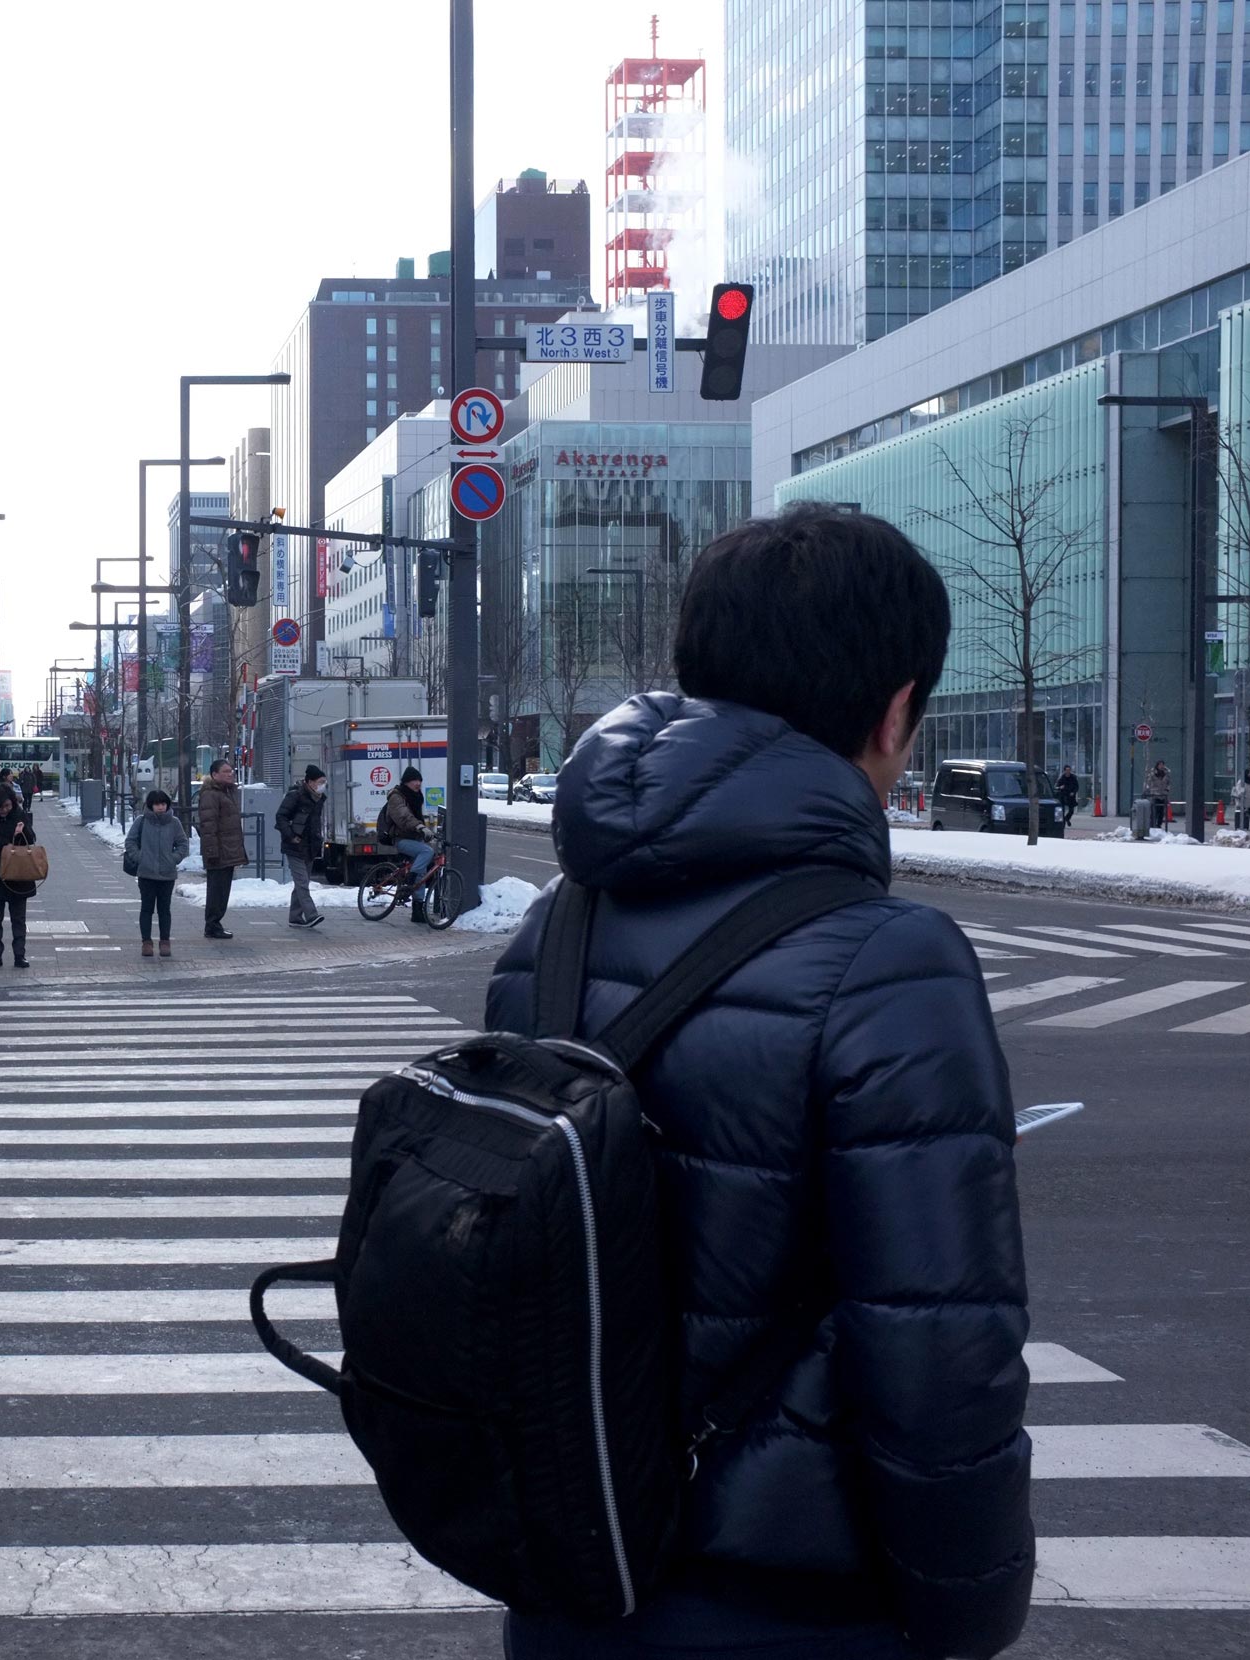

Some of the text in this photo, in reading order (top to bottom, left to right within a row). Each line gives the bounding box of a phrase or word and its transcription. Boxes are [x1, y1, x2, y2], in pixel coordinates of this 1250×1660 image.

[536, 327, 625, 347] 北3西3
[654, 298, 667, 389] 歩車分離信号機
[540, 348, 570, 359] North
[584, 348, 611, 359] West
[557, 450, 667, 469] Akarenga
[276, 537, 285, 602] 斜め横断専用
[367, 751, 392, 759] EXPRESS
